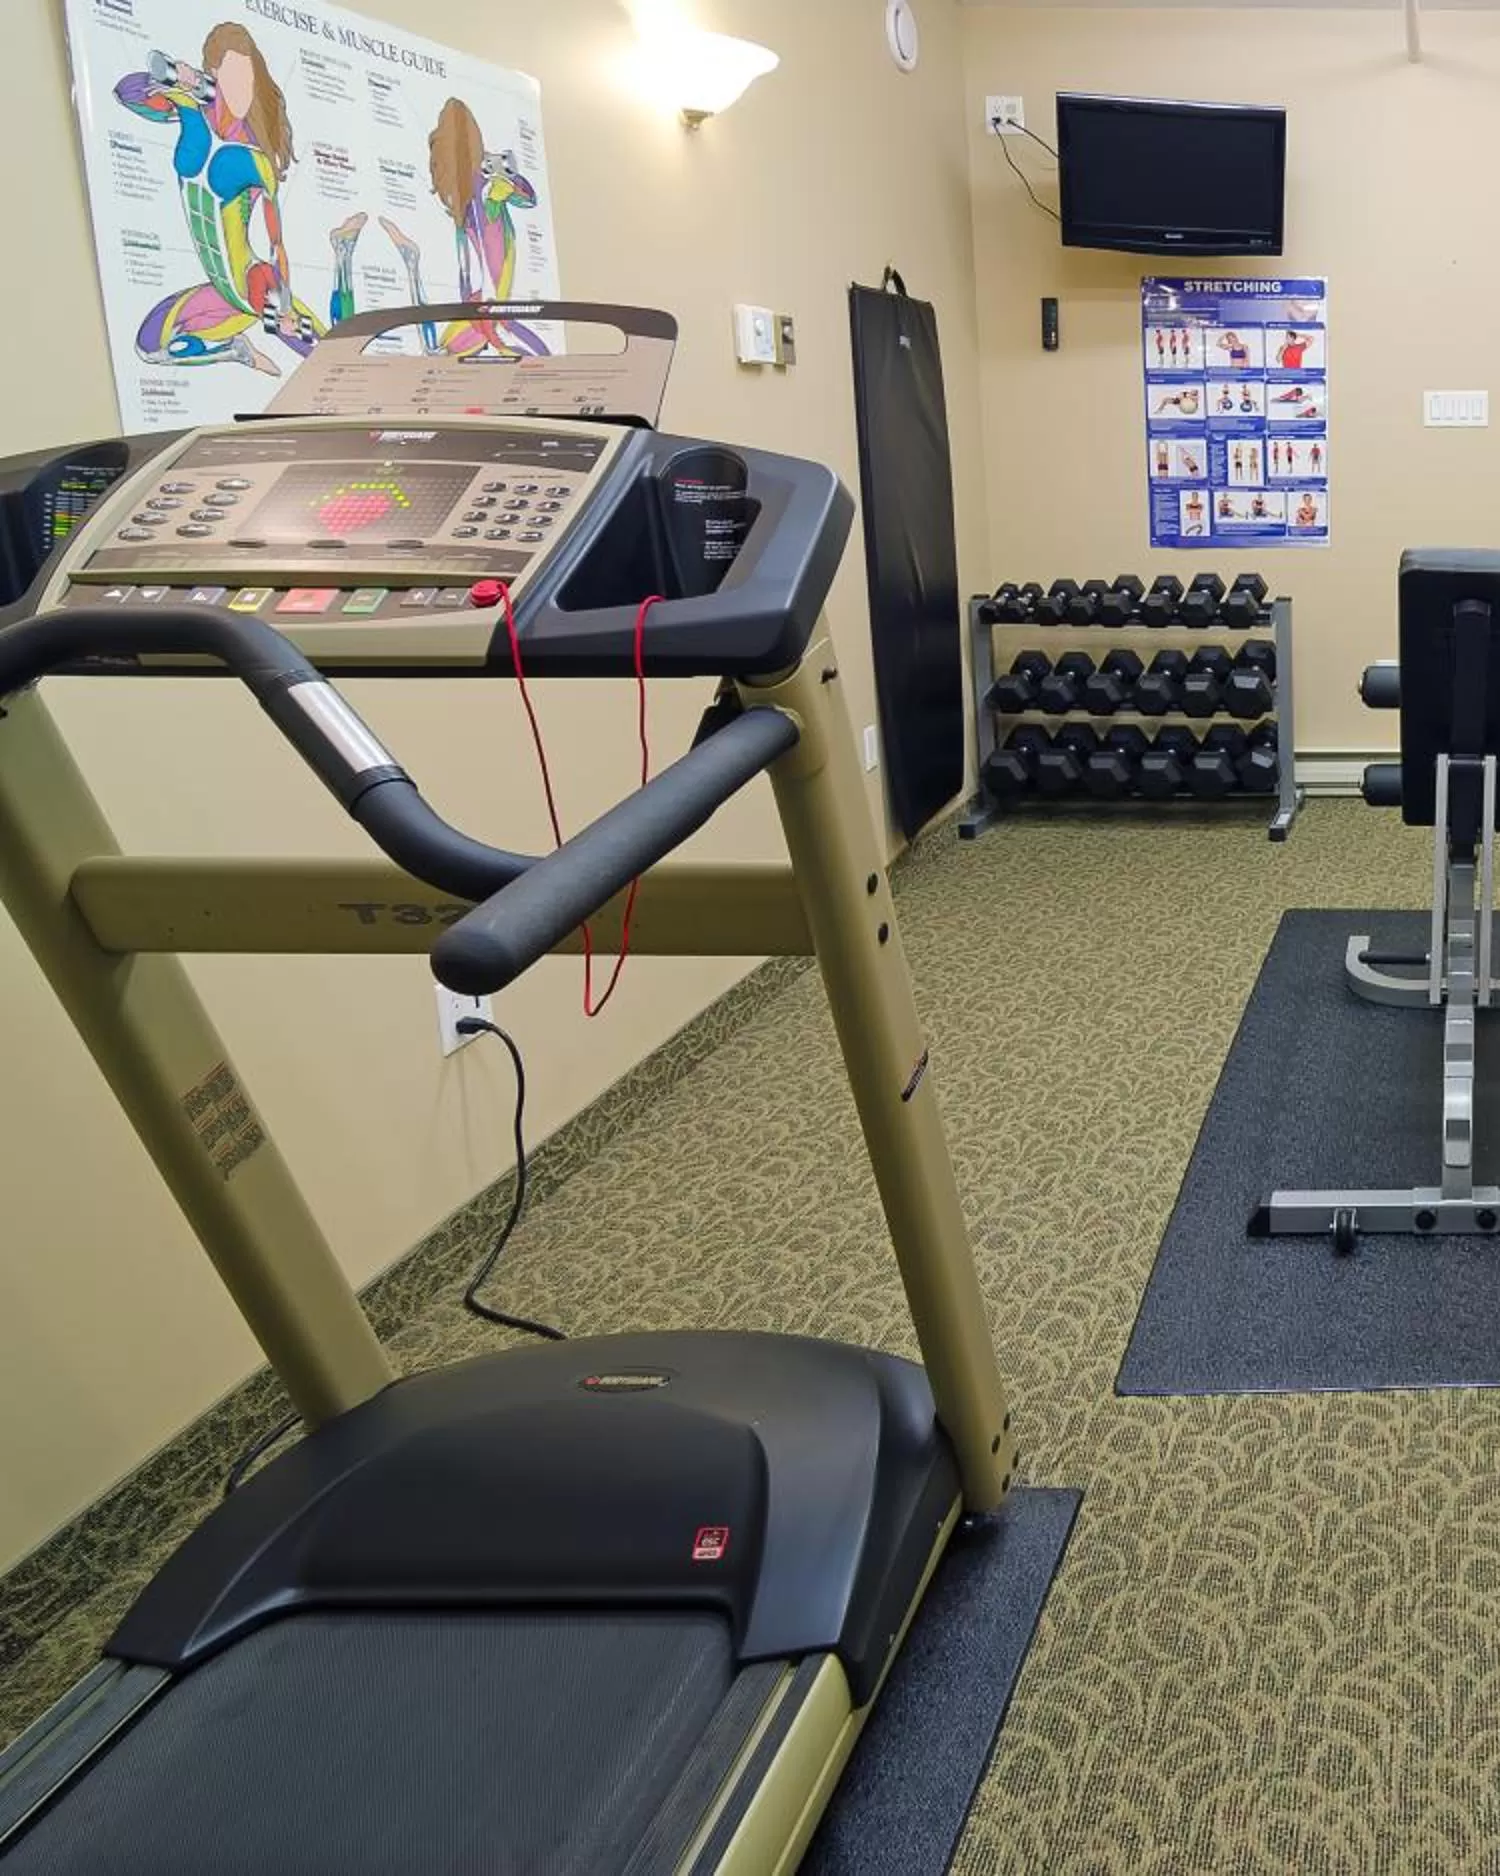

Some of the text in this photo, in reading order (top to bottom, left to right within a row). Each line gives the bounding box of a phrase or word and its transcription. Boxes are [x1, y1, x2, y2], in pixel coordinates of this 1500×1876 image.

[321, 19, 336, 42] &
[338, 26, 402, 63] MUSCLE
[401, 50, 448, 79] GUIDE
[1184, 281, 1283, 293] STRETCHING
